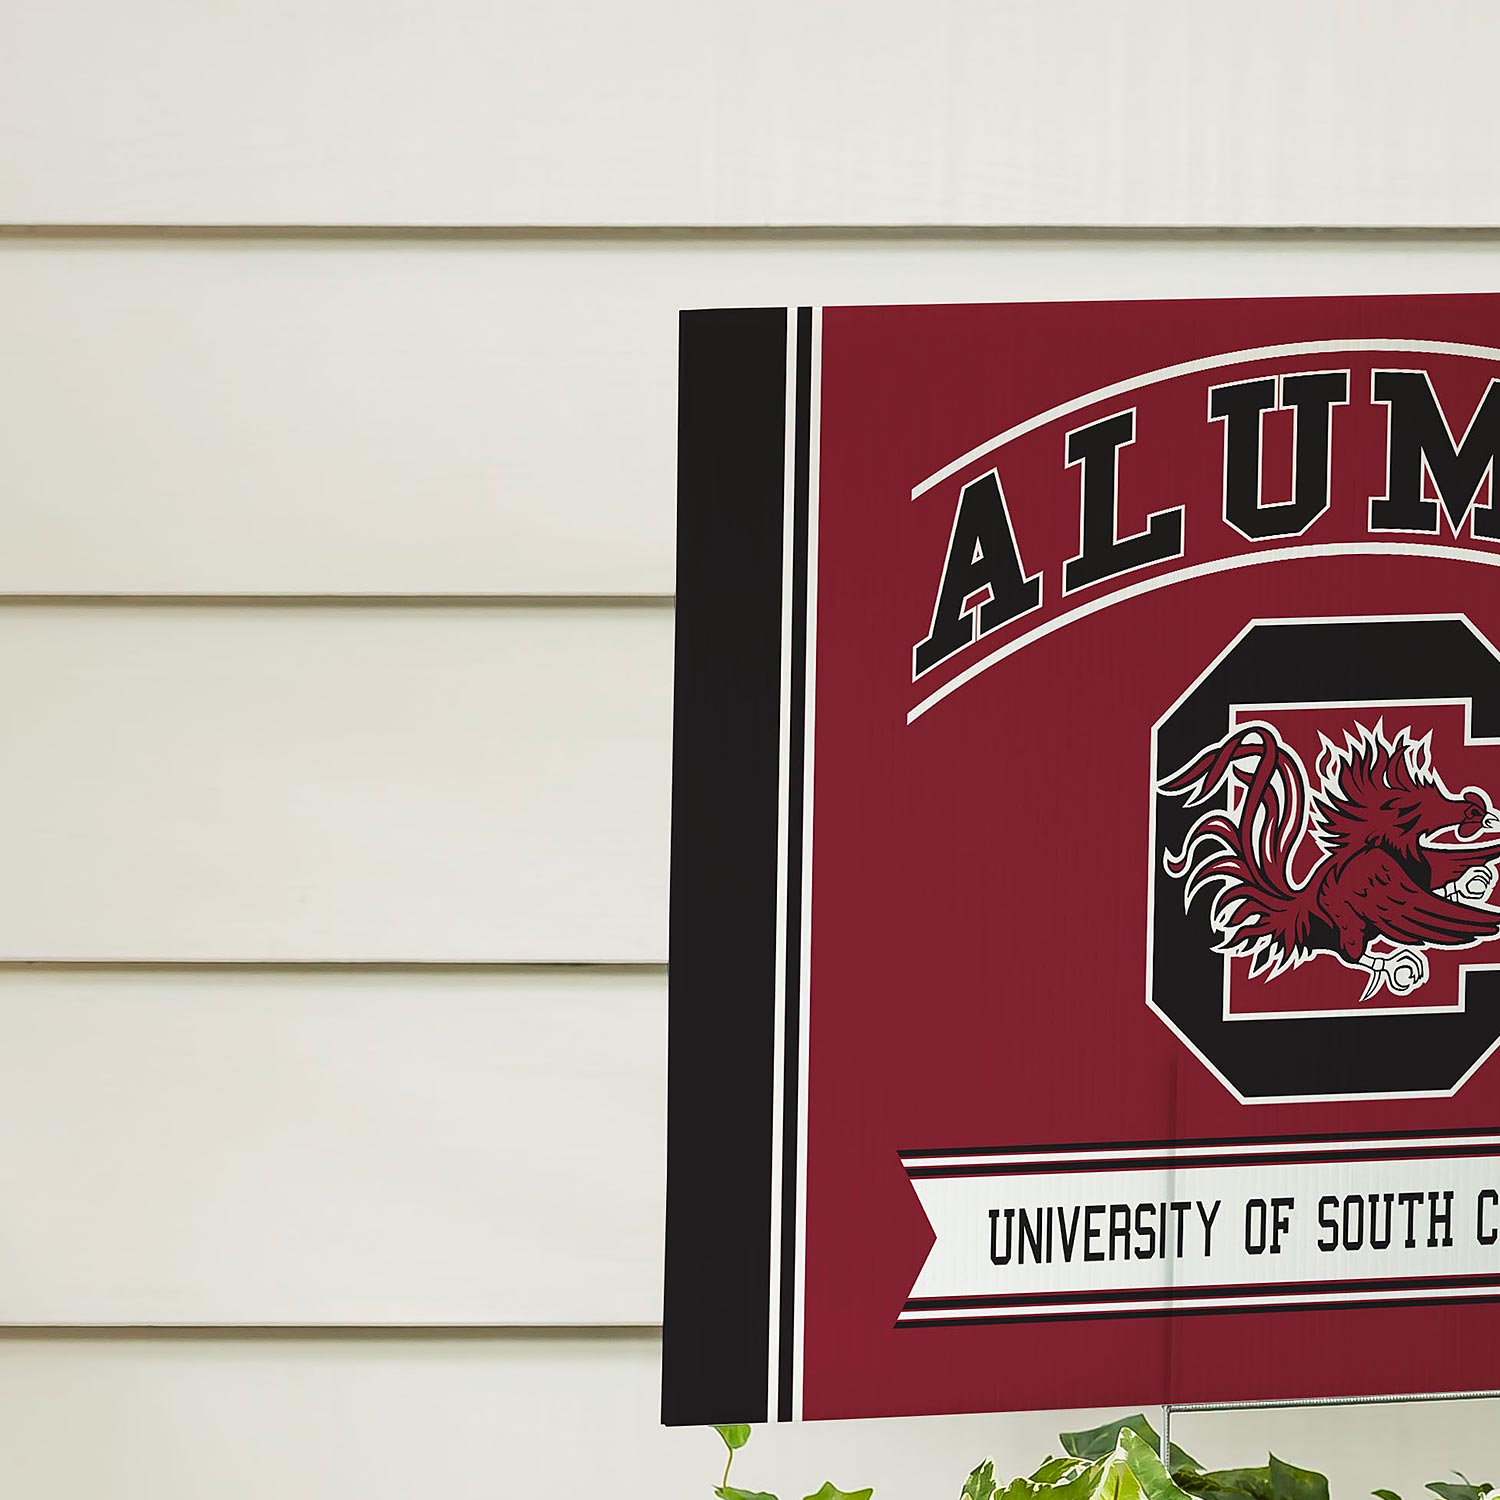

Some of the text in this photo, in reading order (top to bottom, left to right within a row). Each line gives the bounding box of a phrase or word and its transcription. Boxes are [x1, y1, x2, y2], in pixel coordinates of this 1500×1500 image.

[988, 1199, 1222, 1266] UNIVERSITY
[1245, 1196, 1296, 1255] OF
[1316, 1190, 1455, 1252] SOUTH
